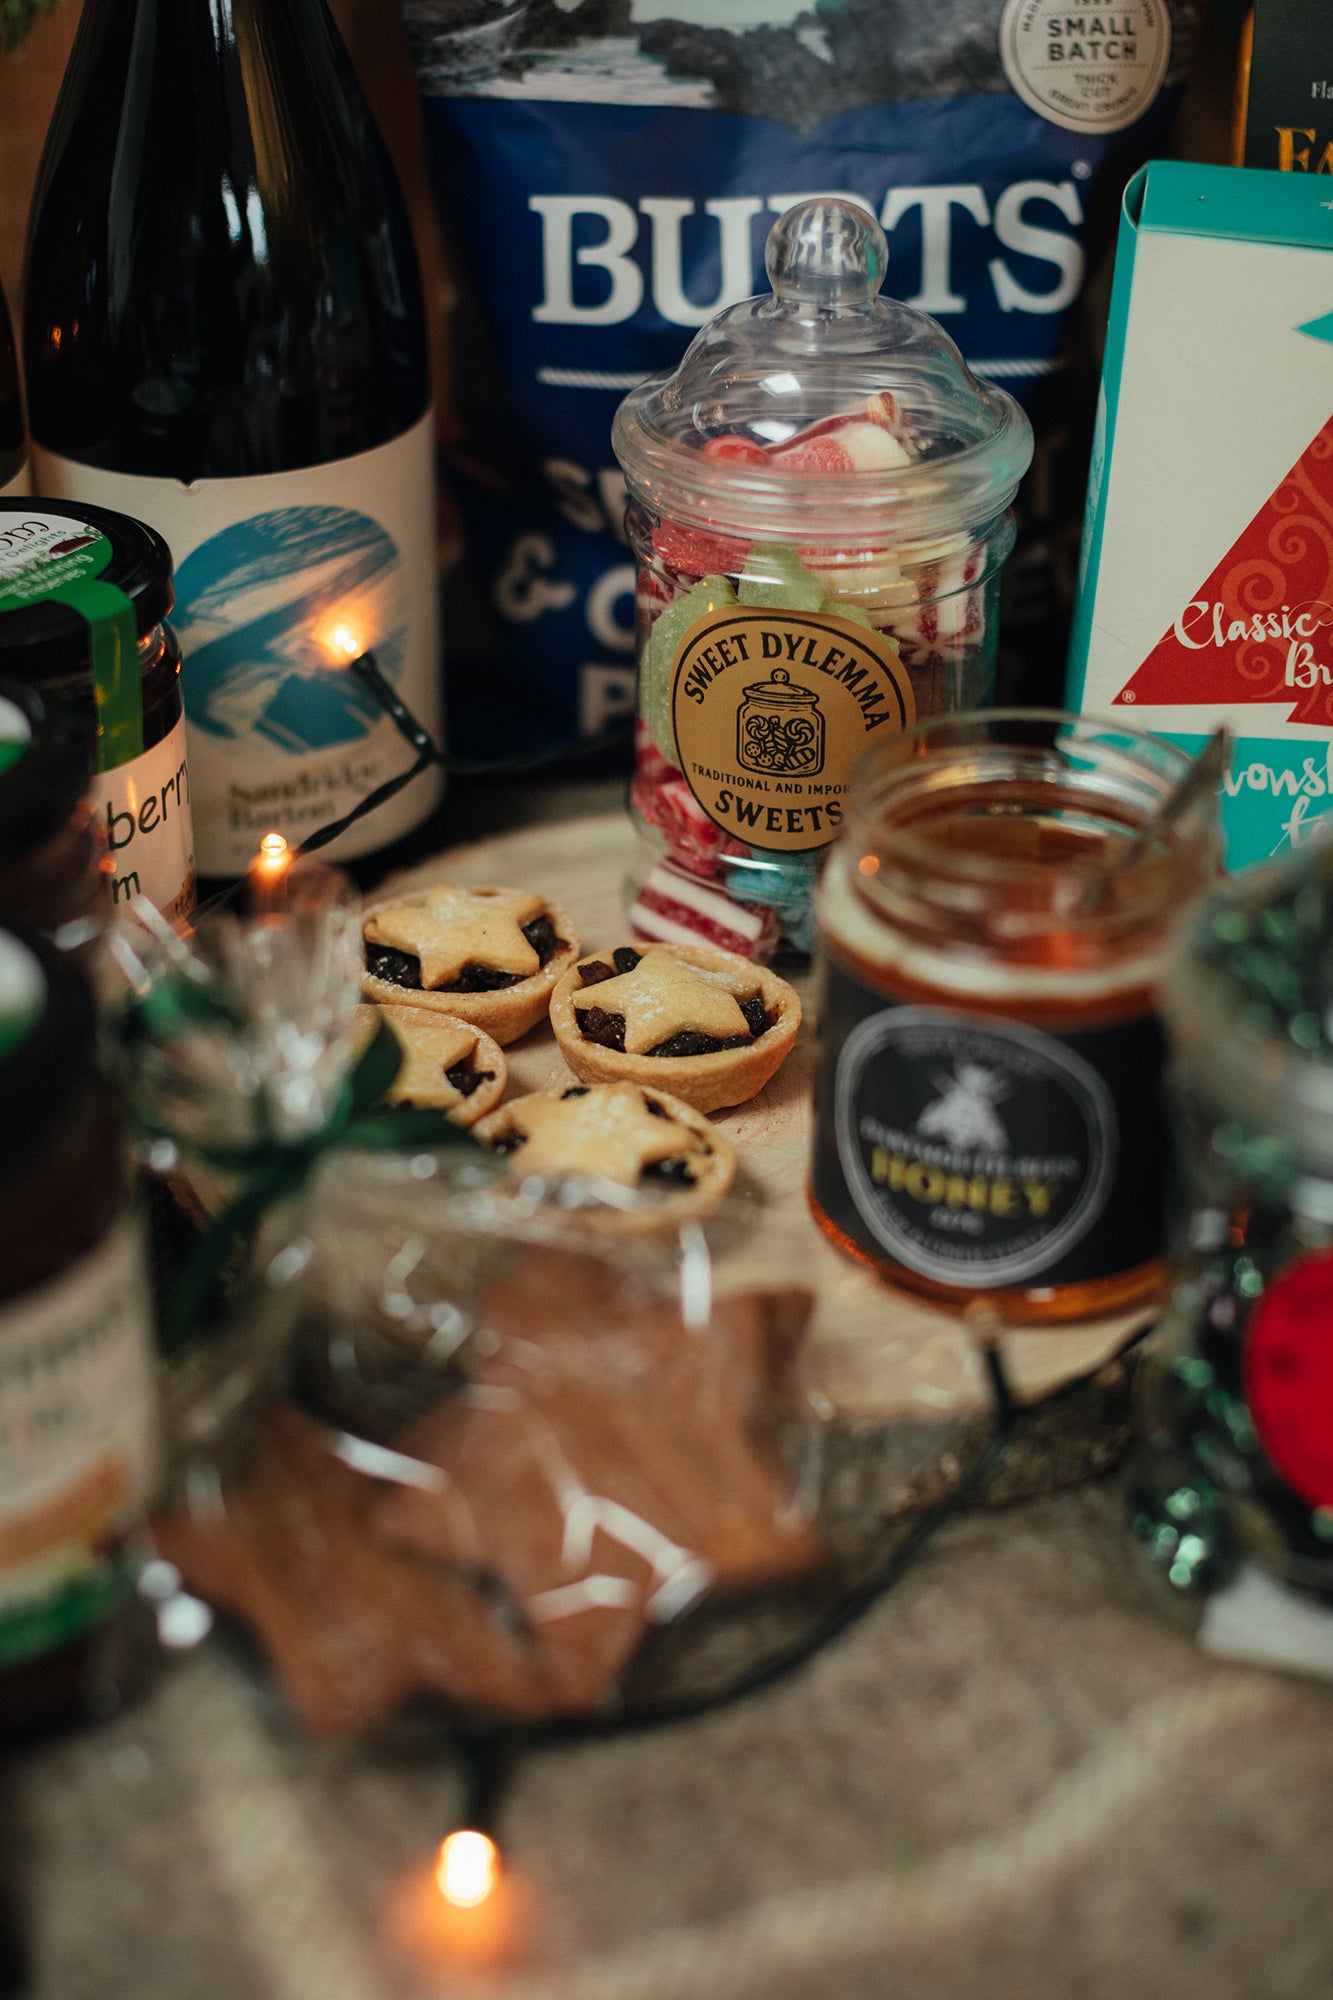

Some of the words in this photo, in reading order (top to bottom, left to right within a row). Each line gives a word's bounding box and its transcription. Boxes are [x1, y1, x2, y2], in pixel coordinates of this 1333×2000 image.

[1047, 17, 1137, 38] SMALL
[1047, 41, 1138, 61] BATCH
[529, 181, 1085, 326] BUTS
[5, 529, 67, 559] Delights
[1158, 600, 1315, 649] Classic
[684, 633, 750, 705] SWEET
[760, 631, 891, 732] DYLEMMA
[691, 762, 771, 793] TRADITIONAL
[775, 782, 802, 795] AND
[714, 789, 845, 834] SWEETS
[871, 1144, 1058, 1219] HONEY
